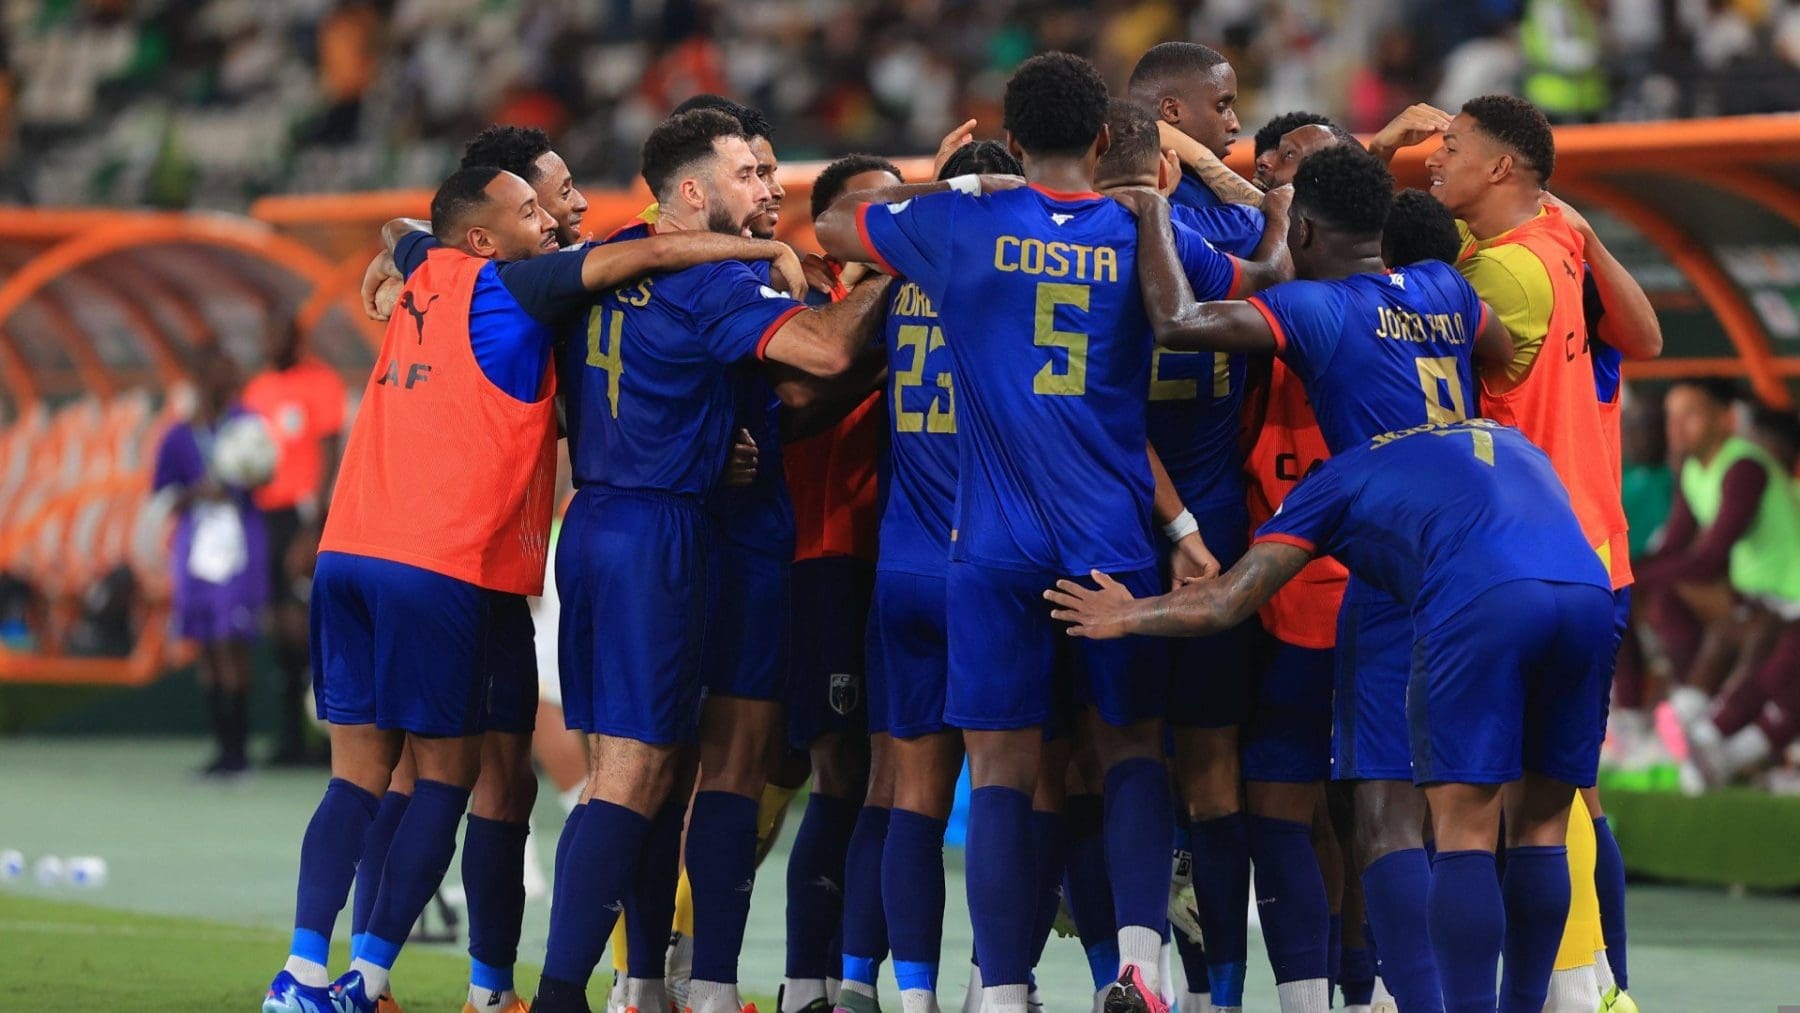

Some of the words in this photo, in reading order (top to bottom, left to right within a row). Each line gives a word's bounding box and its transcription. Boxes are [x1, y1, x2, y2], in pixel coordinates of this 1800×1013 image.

[994, 235, 1118, 283] COSTA
[585, 305, 624, 419] 4
[1033, 281, 1091, 396] 5
[1566, 331, 1589, 362] C
